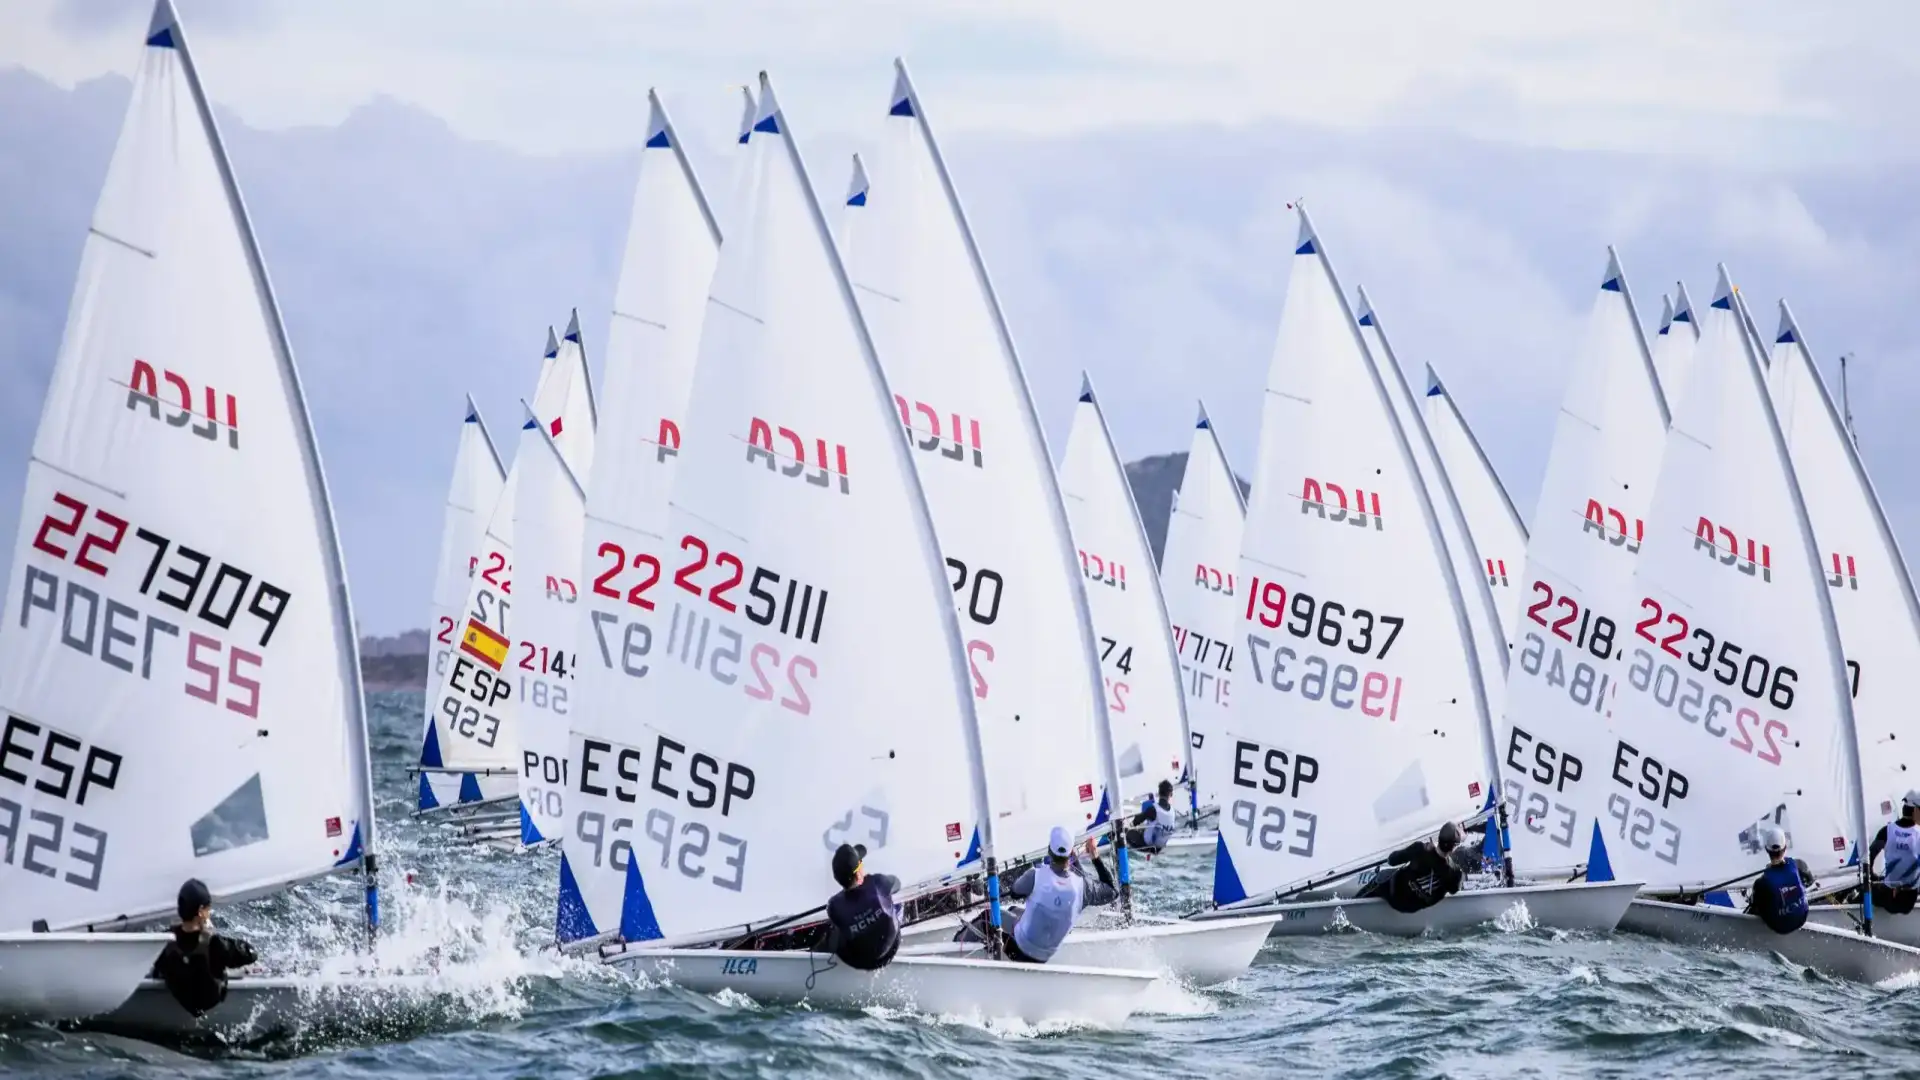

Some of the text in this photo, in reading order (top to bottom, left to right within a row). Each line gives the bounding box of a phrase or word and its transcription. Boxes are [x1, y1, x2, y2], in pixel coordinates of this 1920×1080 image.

[33, 491, 292, 648] 227309
[593, 542, 661, 611] 22
[674, 535, 828, 644] 225111
[1246, 577, 1404, 660] 199637
[1527, 580, 1622, 661] 2218
[1635, 597, 1798, 710] 223506
[450, 657, 511, 707] ESP
[0, 715, 122, 806] ESP
[652, 735, 755, 817] ESP
[1234, 741, 1319, 798] ESP
[1507, 724, 1583, 793] ESP
[1612, 740, 1689, 809] ESP
[722, 957, 757, 975] ILCA
